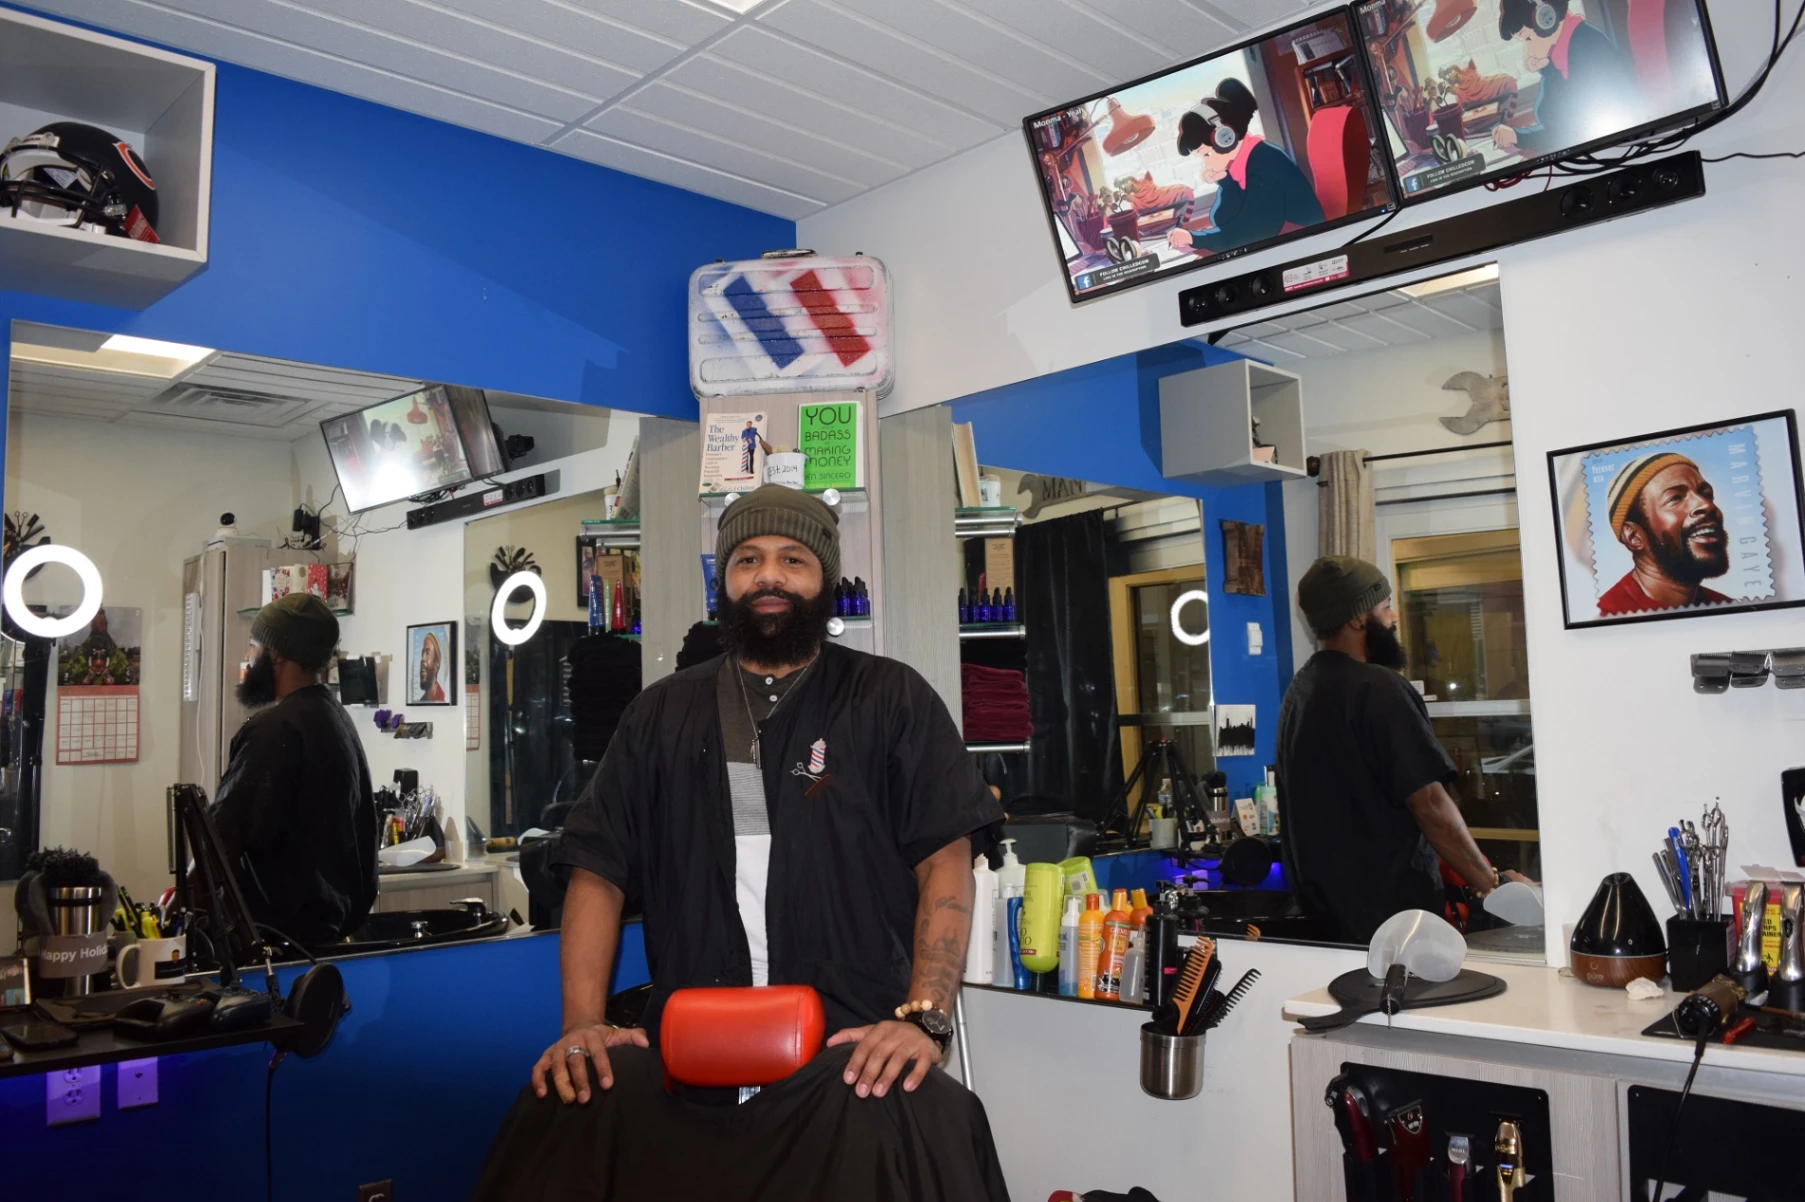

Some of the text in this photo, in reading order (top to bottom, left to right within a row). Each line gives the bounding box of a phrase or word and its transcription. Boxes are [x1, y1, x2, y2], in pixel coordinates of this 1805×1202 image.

[1033, 116, 1061, 129] Monma
[1066, 107, 1084, 117] Yeah
[1427, 170, 1445, 179] FOLLOW
[1100, 267, 1118, 277] FOLLOW
[805, 406, 851, 425] YOU
[709, 424, 724, 434] The
[708, 433, 740, 444] Wealthy
[805, 429, 851, 442] BADASS
[706, 444, 735, 452] Barber
[805, 445, 851, 456] MAKING
[1592, 464, 1615, 474] forever
[819, 472, 851, 480] SINCERO
[1043, 477, 1082, 501] MAN
[1727, 443, 1762, 588] MARVIN GAYE
[41, 949, 77, 963] Happy
